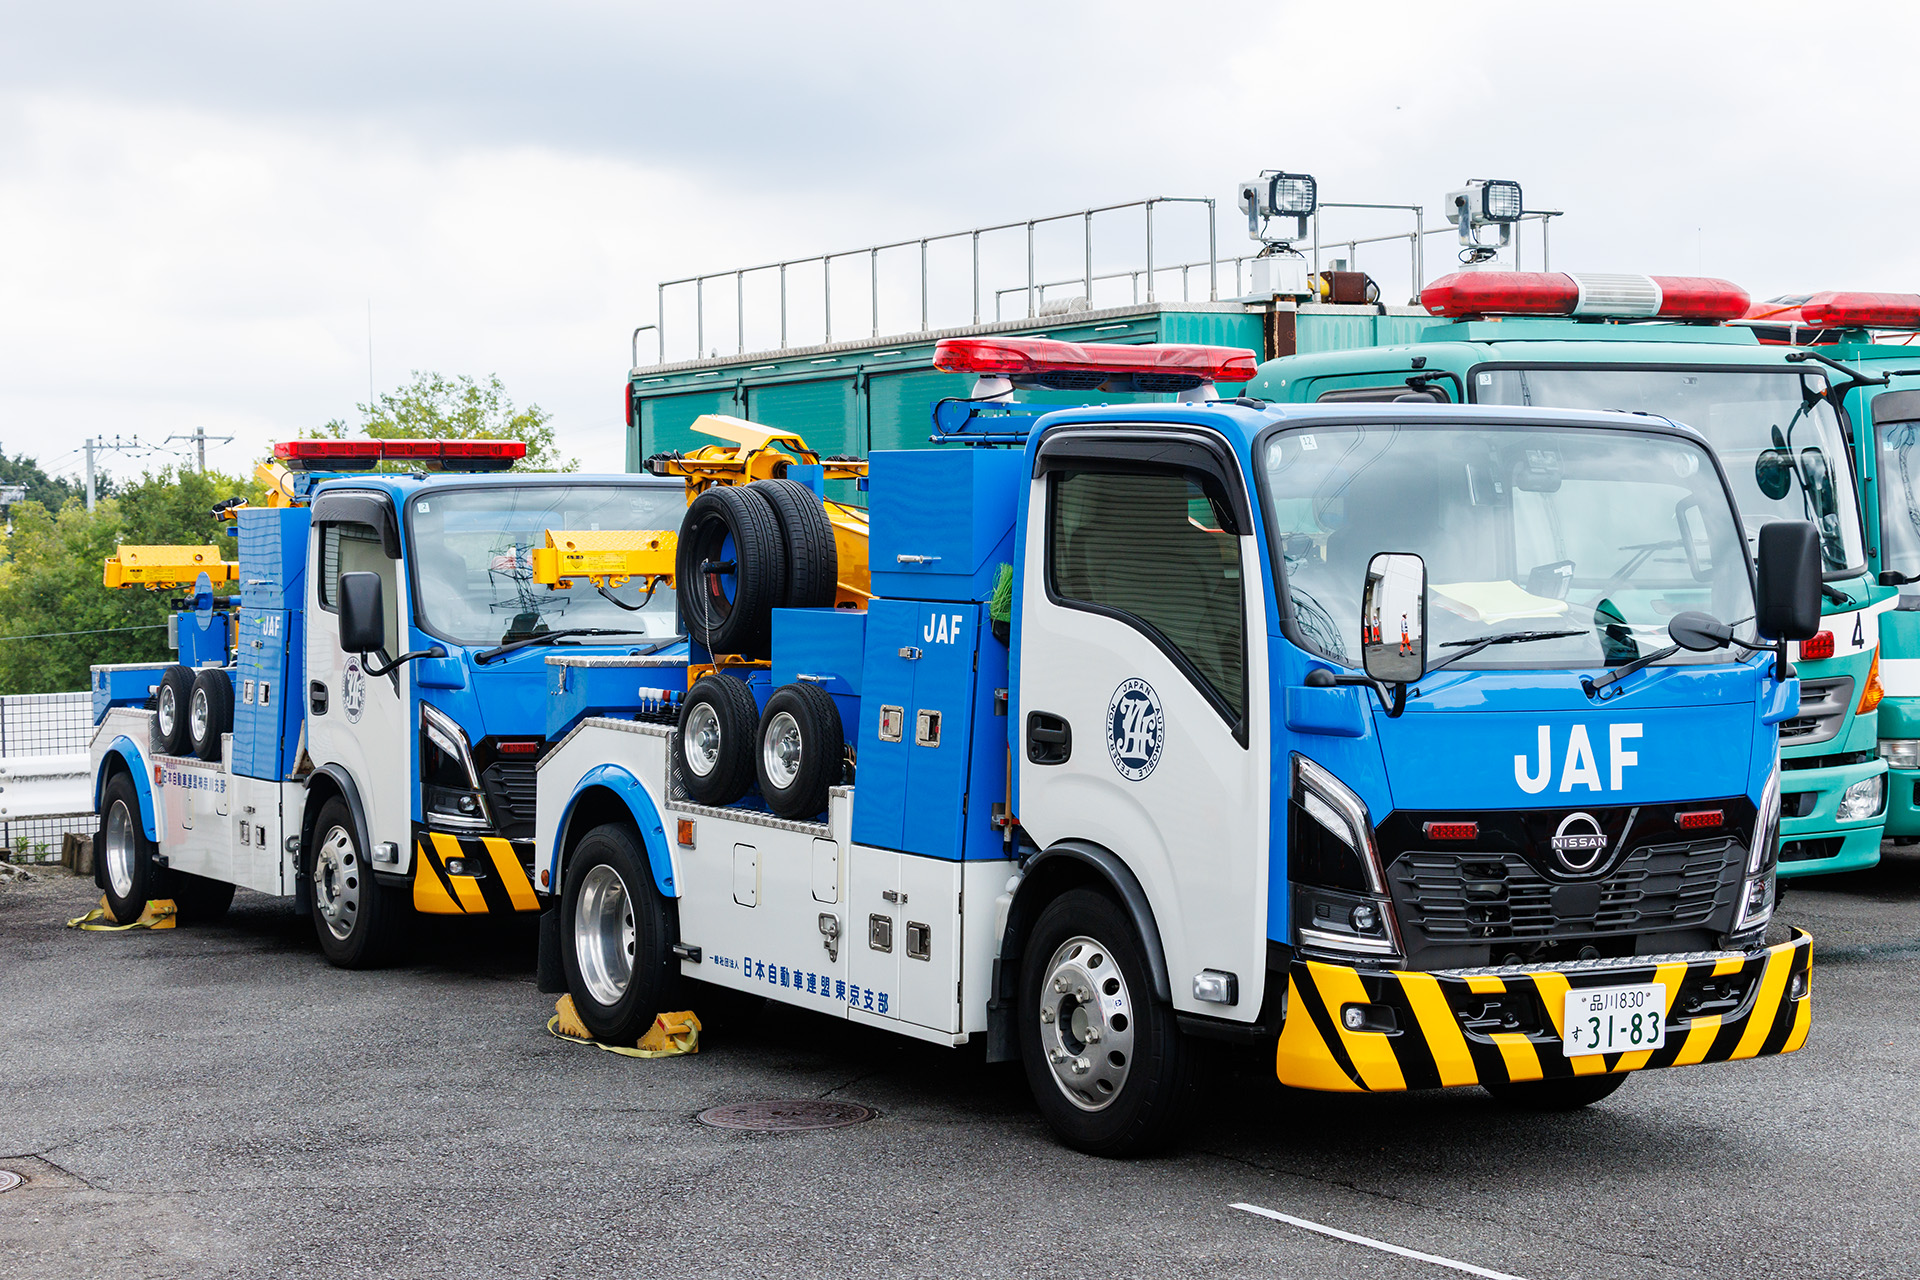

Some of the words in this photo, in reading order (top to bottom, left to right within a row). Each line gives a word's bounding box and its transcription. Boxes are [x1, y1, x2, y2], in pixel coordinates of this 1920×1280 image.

[262, 615, 281, 637] JAF
[923, 613, 963, 645] JAF
[1851, 611, 1865, 649] 4
[1122, 681, 1152, 696] JAPAN
[1138, 707, 1163, 778] AUTOMOBILE
[1514, 722, 1643, 794] JAF
[1553, 837, 1607, 849] NISSAN
[743, 956, 889, 1015] 日本自動車連盟東京支部
[1571, 1025, 1583, 1043] す
[1586, 1011, 1660, 1049] 31-83
